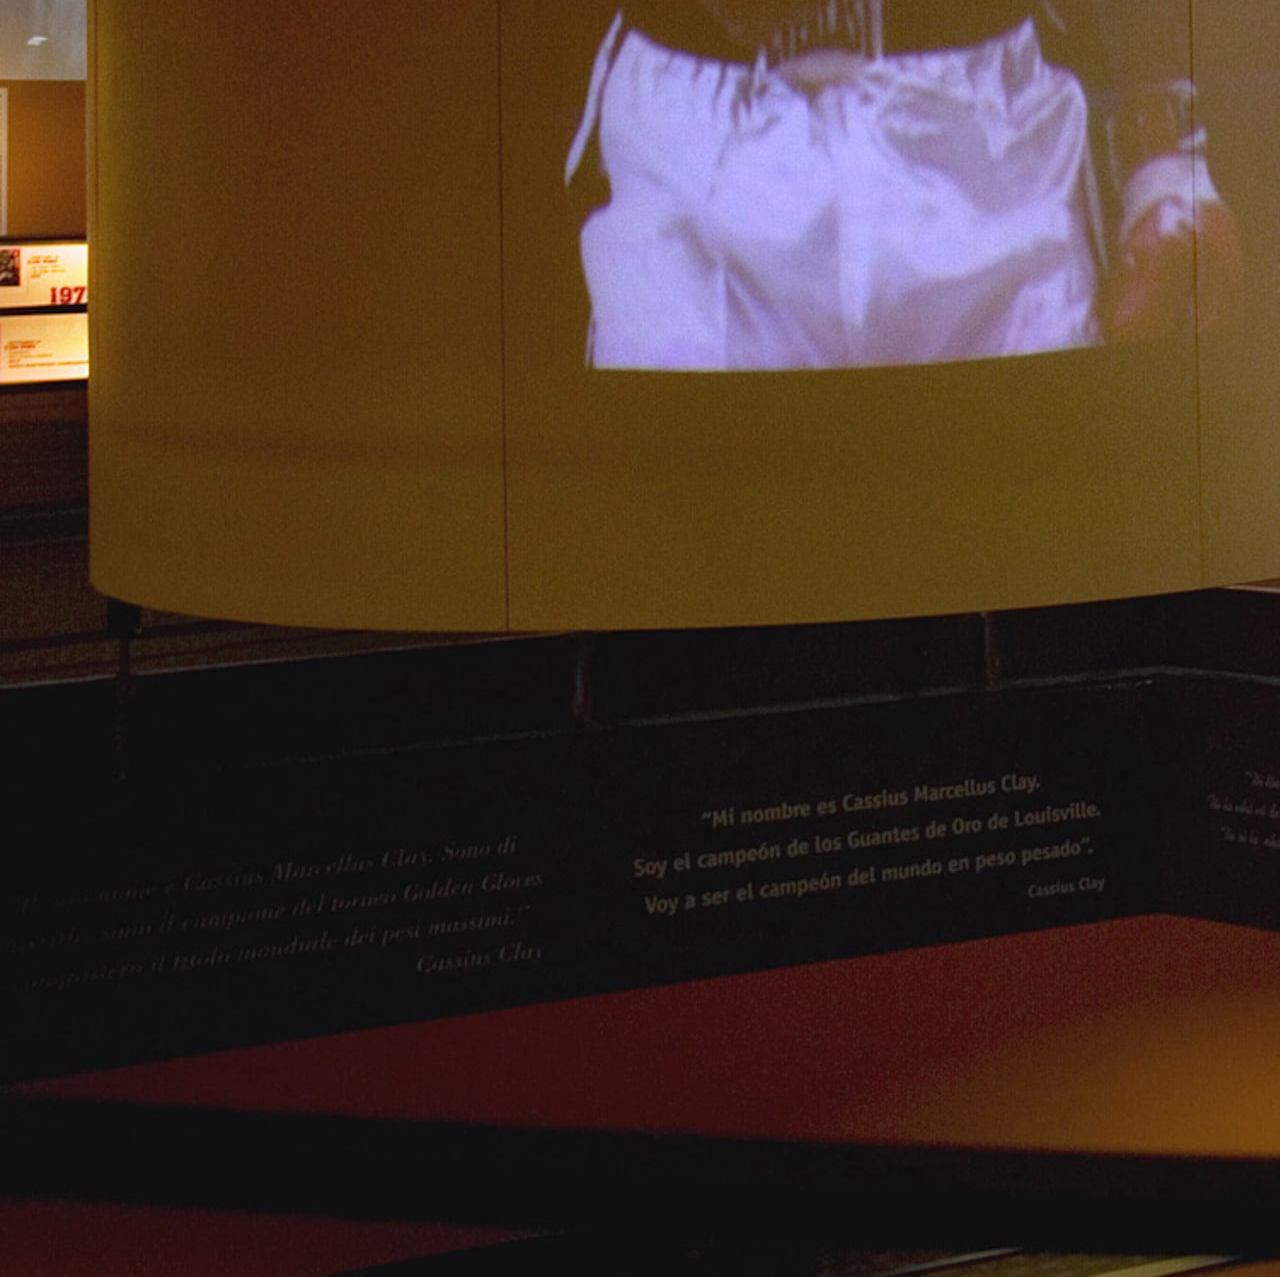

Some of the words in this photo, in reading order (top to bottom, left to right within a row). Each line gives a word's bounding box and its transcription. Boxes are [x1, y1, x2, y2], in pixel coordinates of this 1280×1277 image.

[700, 810, 735, 829] “Mi
[740, 800, 811, 827] nombre
[816, 798, 838, 816] es
[842, 791, 909, 813] Cassius
[913, 779, 997, 806] Marcellus
[1000, 773, 1041, 796] Clay.
[273, 853, 374, 882] Marcellus
[441, 841, 491, 861] Sono
[496, 834, 519, 855] di
[633, 857, 668, 880] Soy
[672, 854, 691, 872] el
[696, 843, 781, 874] campeón
[786, 838, 810, 857] de
[814, 834, 842, 854] los
[847, 825, 920, 850] Guantes
[924, 821, 947, 840] de
[952, 816, 982, 836] Oro
[987, 812, 1009, 831] de
[1014, 800, 1102, 828] Louisville.
[403, 878, 474, 903] Golden
[480, 872, 545, 894] Gloves
[645, 895, 679, 917] Voy
[683, 893, 697, 911] a
[701, 889, 730, 907] ser
[736, 883, 754, 903] el
[759, 871, 843, 905] campeón
[847, 866, 877, 888] del
[881, 857, 943, 884] mundo
[948, 854, 970, 873] en
[975, 847, 1017, 876] peso
[1027, 879, 1075, 900] Cassius
[1078, 875, 1105, 895] Clay
[416, 948, 492, 974] Cassius
[497, 941, 545, 963] Clay
